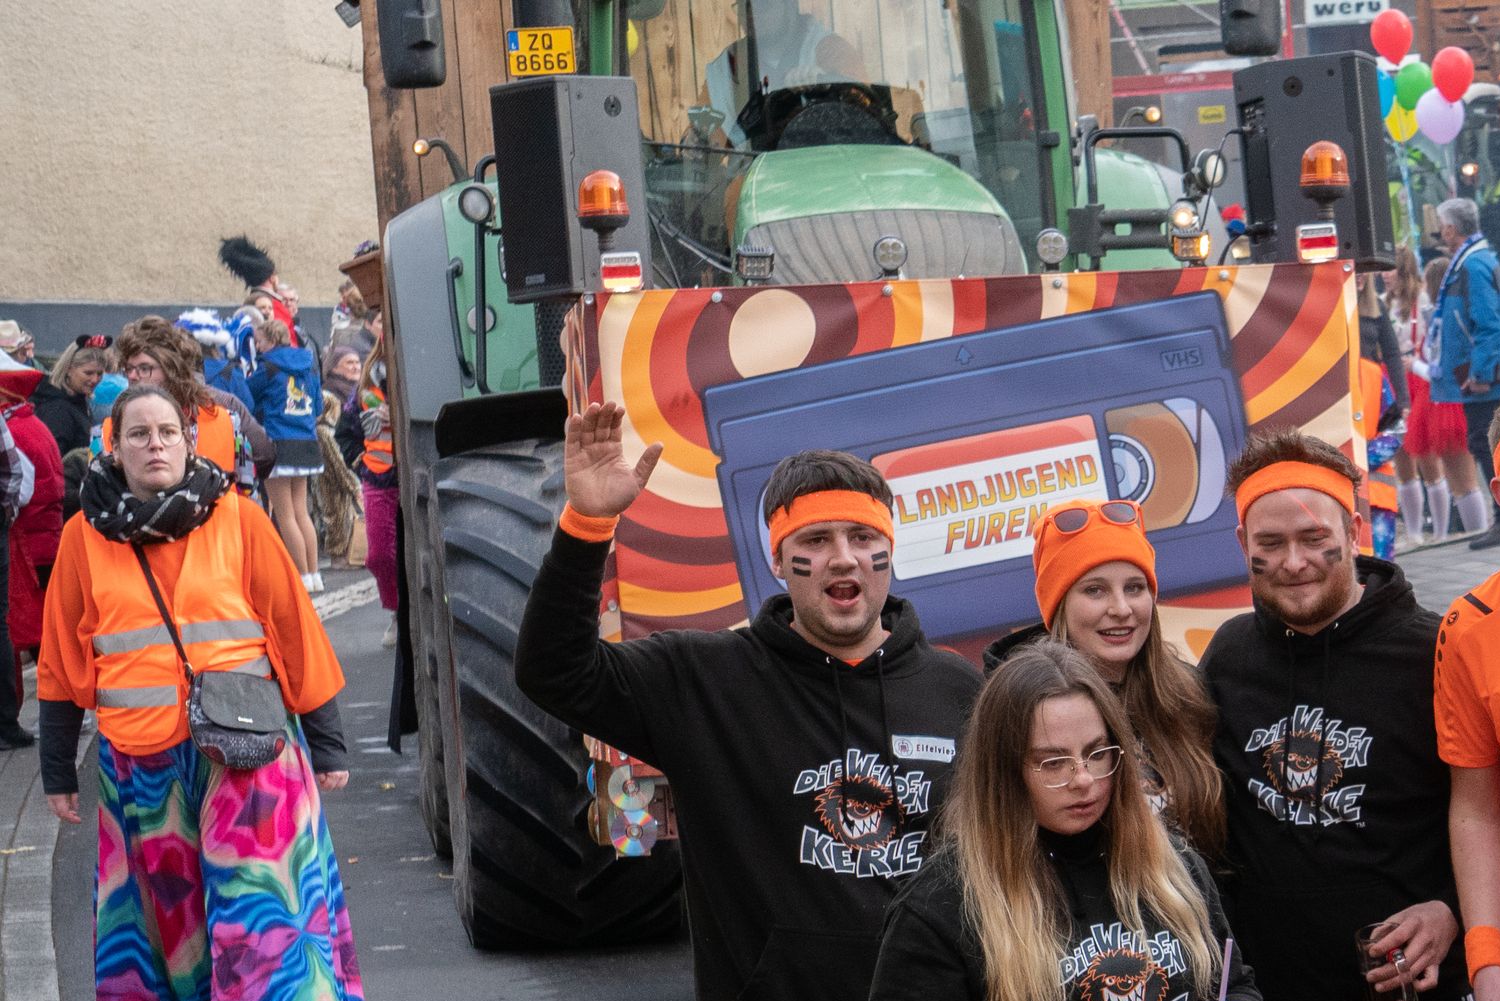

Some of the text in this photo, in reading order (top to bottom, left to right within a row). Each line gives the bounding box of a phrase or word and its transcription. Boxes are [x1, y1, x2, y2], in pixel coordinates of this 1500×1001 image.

[528, 33, 552, 51] ZQ
[516, 53, 568, 71] 8666
[1163, 350, 1200, 367] VHS
[895, 454, 1098, 525] LANDJUGEND
[800, 824, 927, 879] KERLE
